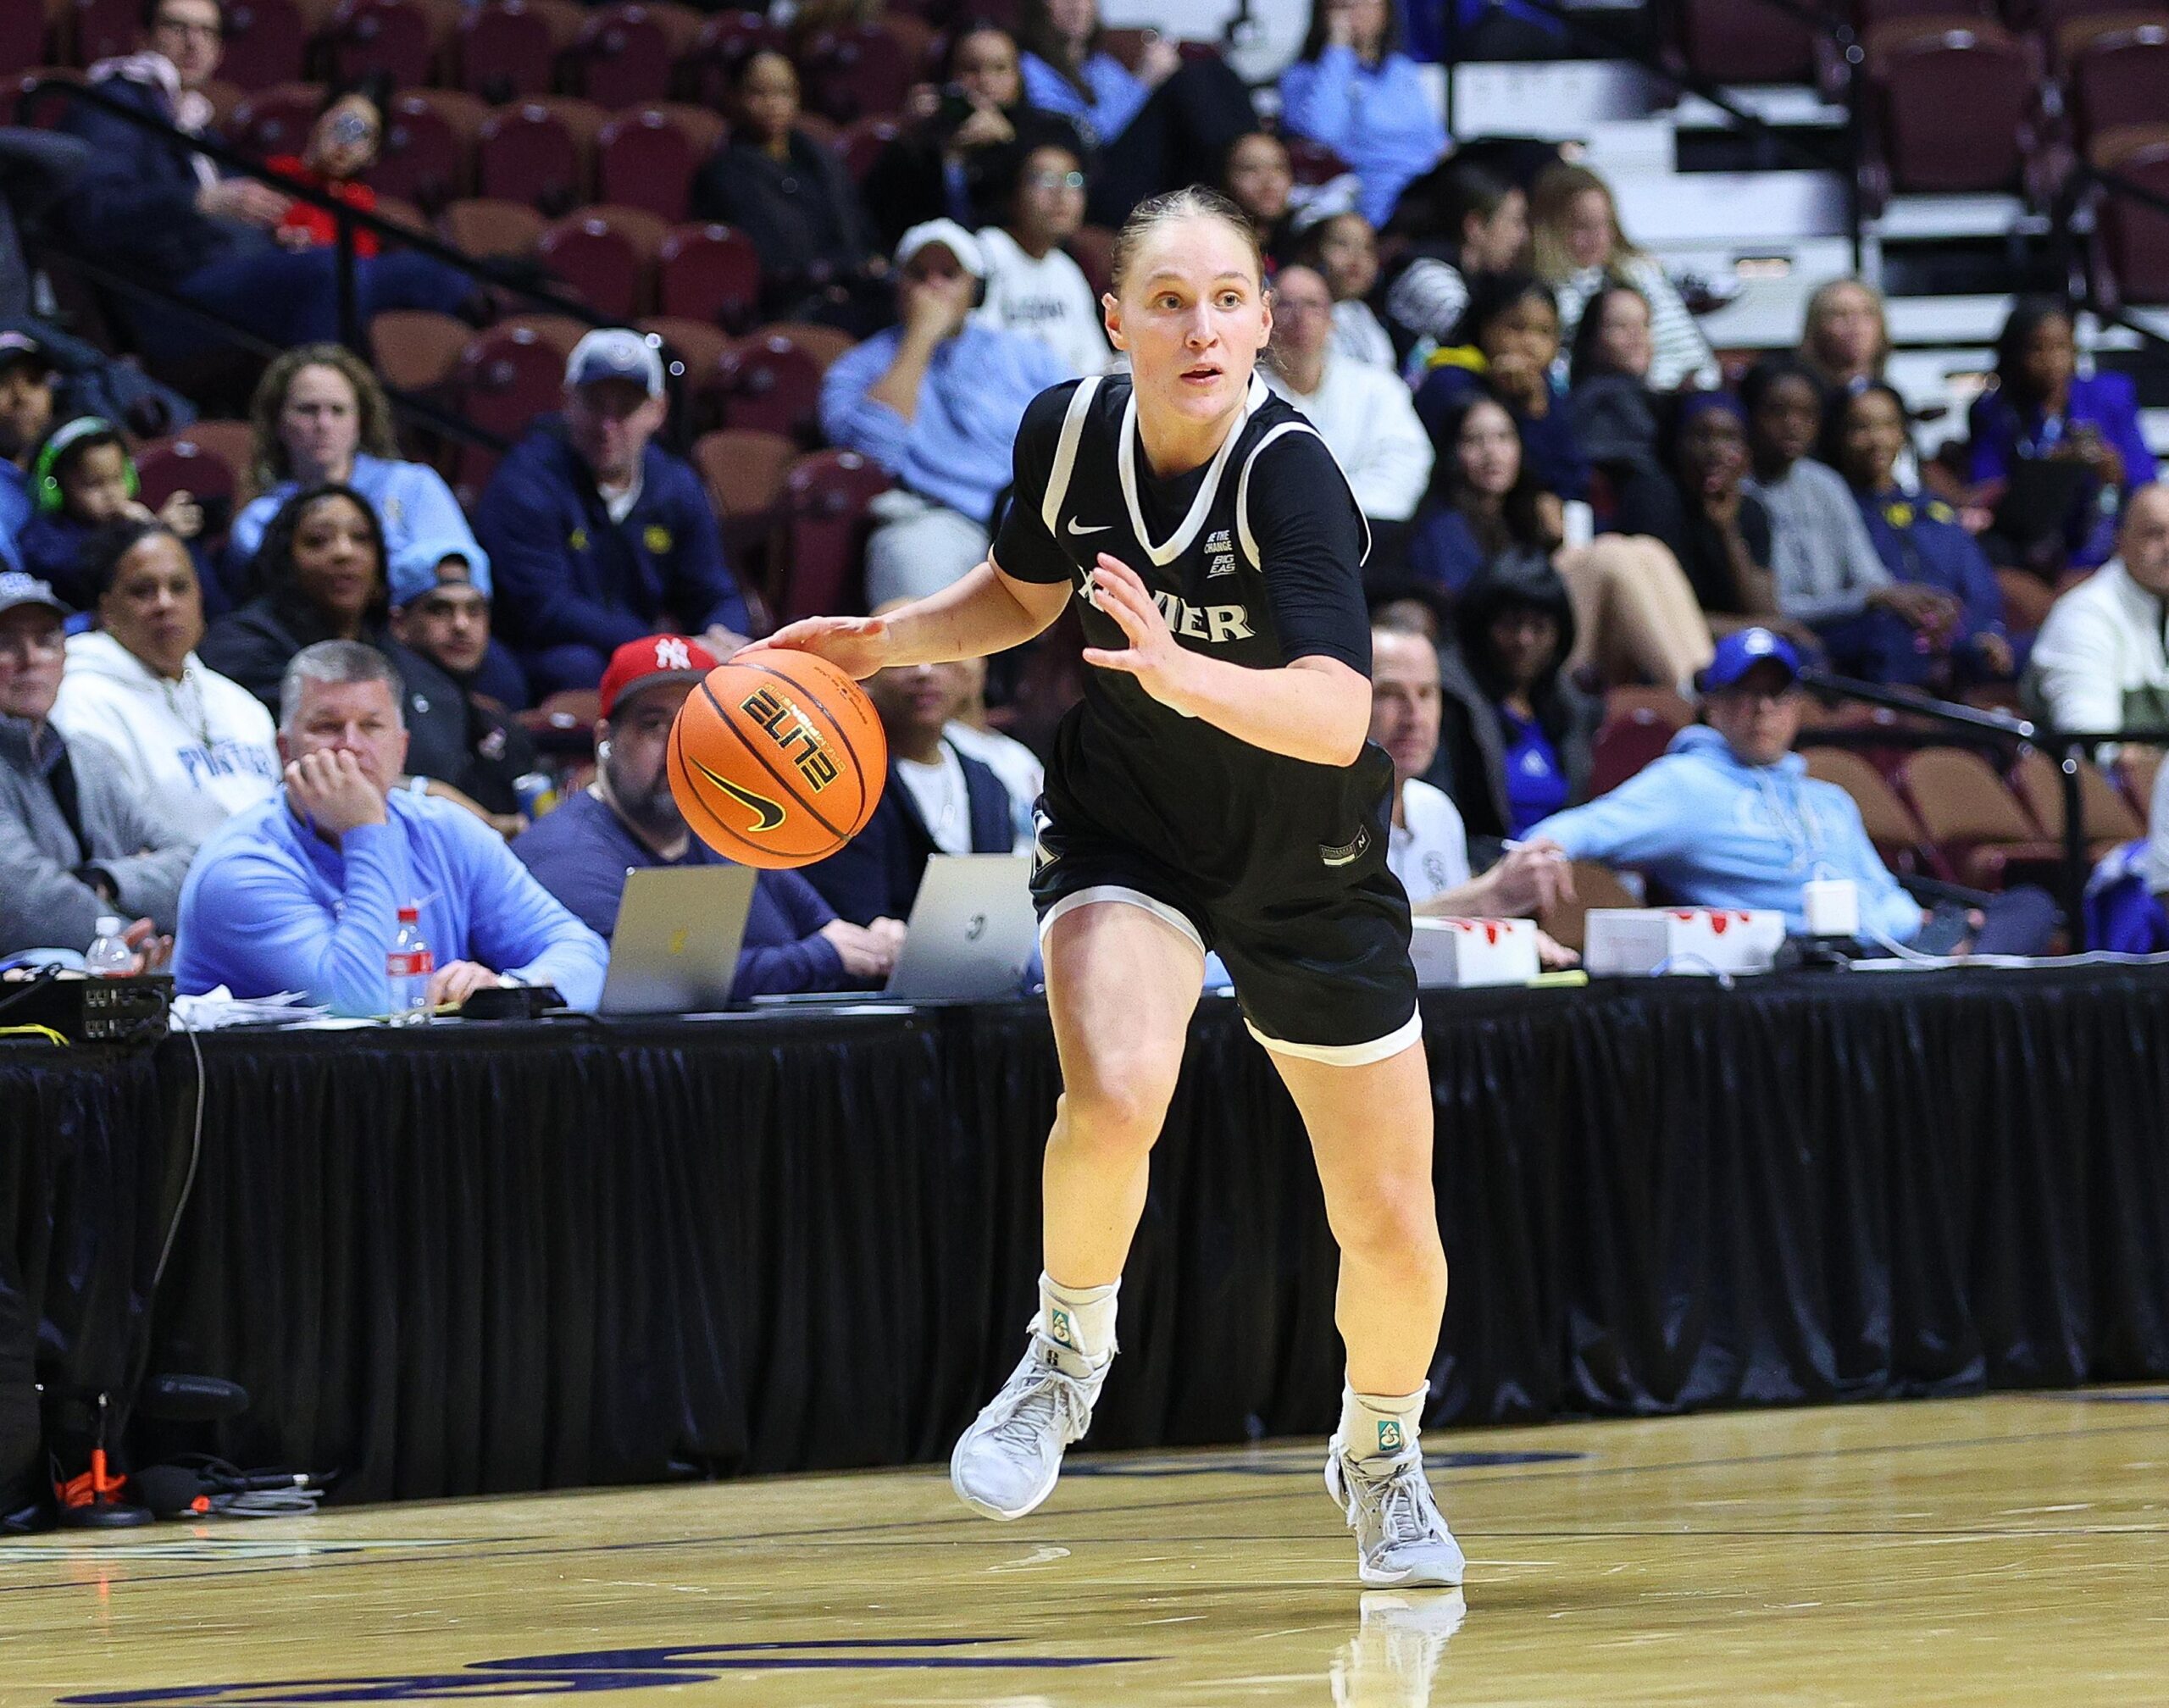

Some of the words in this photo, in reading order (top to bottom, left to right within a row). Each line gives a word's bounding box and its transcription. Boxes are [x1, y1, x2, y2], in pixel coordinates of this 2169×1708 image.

[1217, 530, 1230, 541] THE
[1204, 541, 1234, 554] CHANGE
[1212, 554, 1234, 565] BIG
[654, 637, 692, 670] NY
[739, 687, 840, 794] ELITE
